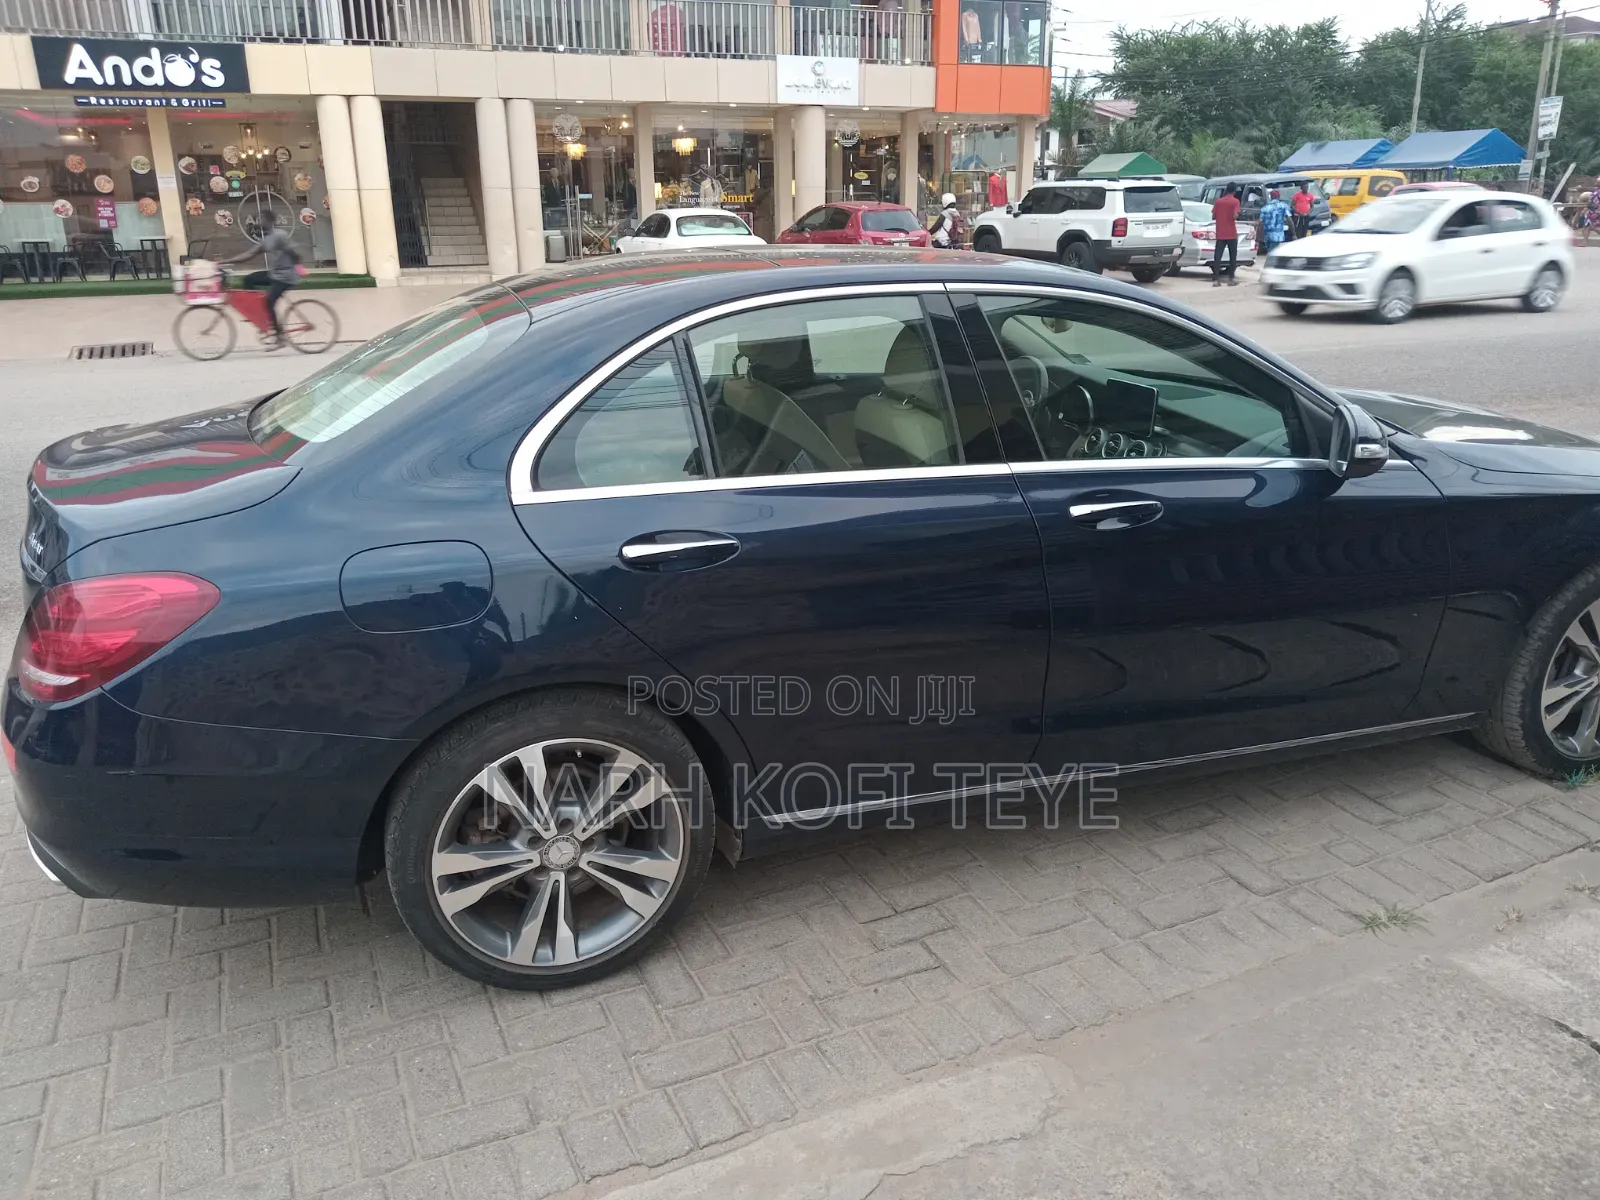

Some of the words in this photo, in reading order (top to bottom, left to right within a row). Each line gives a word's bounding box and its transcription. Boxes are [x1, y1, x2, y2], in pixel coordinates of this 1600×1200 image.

[64, 43, 225, 88] Ando's
[90, 96, 166, 106] Restaurant
[170, 98, 178, 106] &
[181, 98, 211, 107] Grill
[720, 191, 754, 203] Smart
